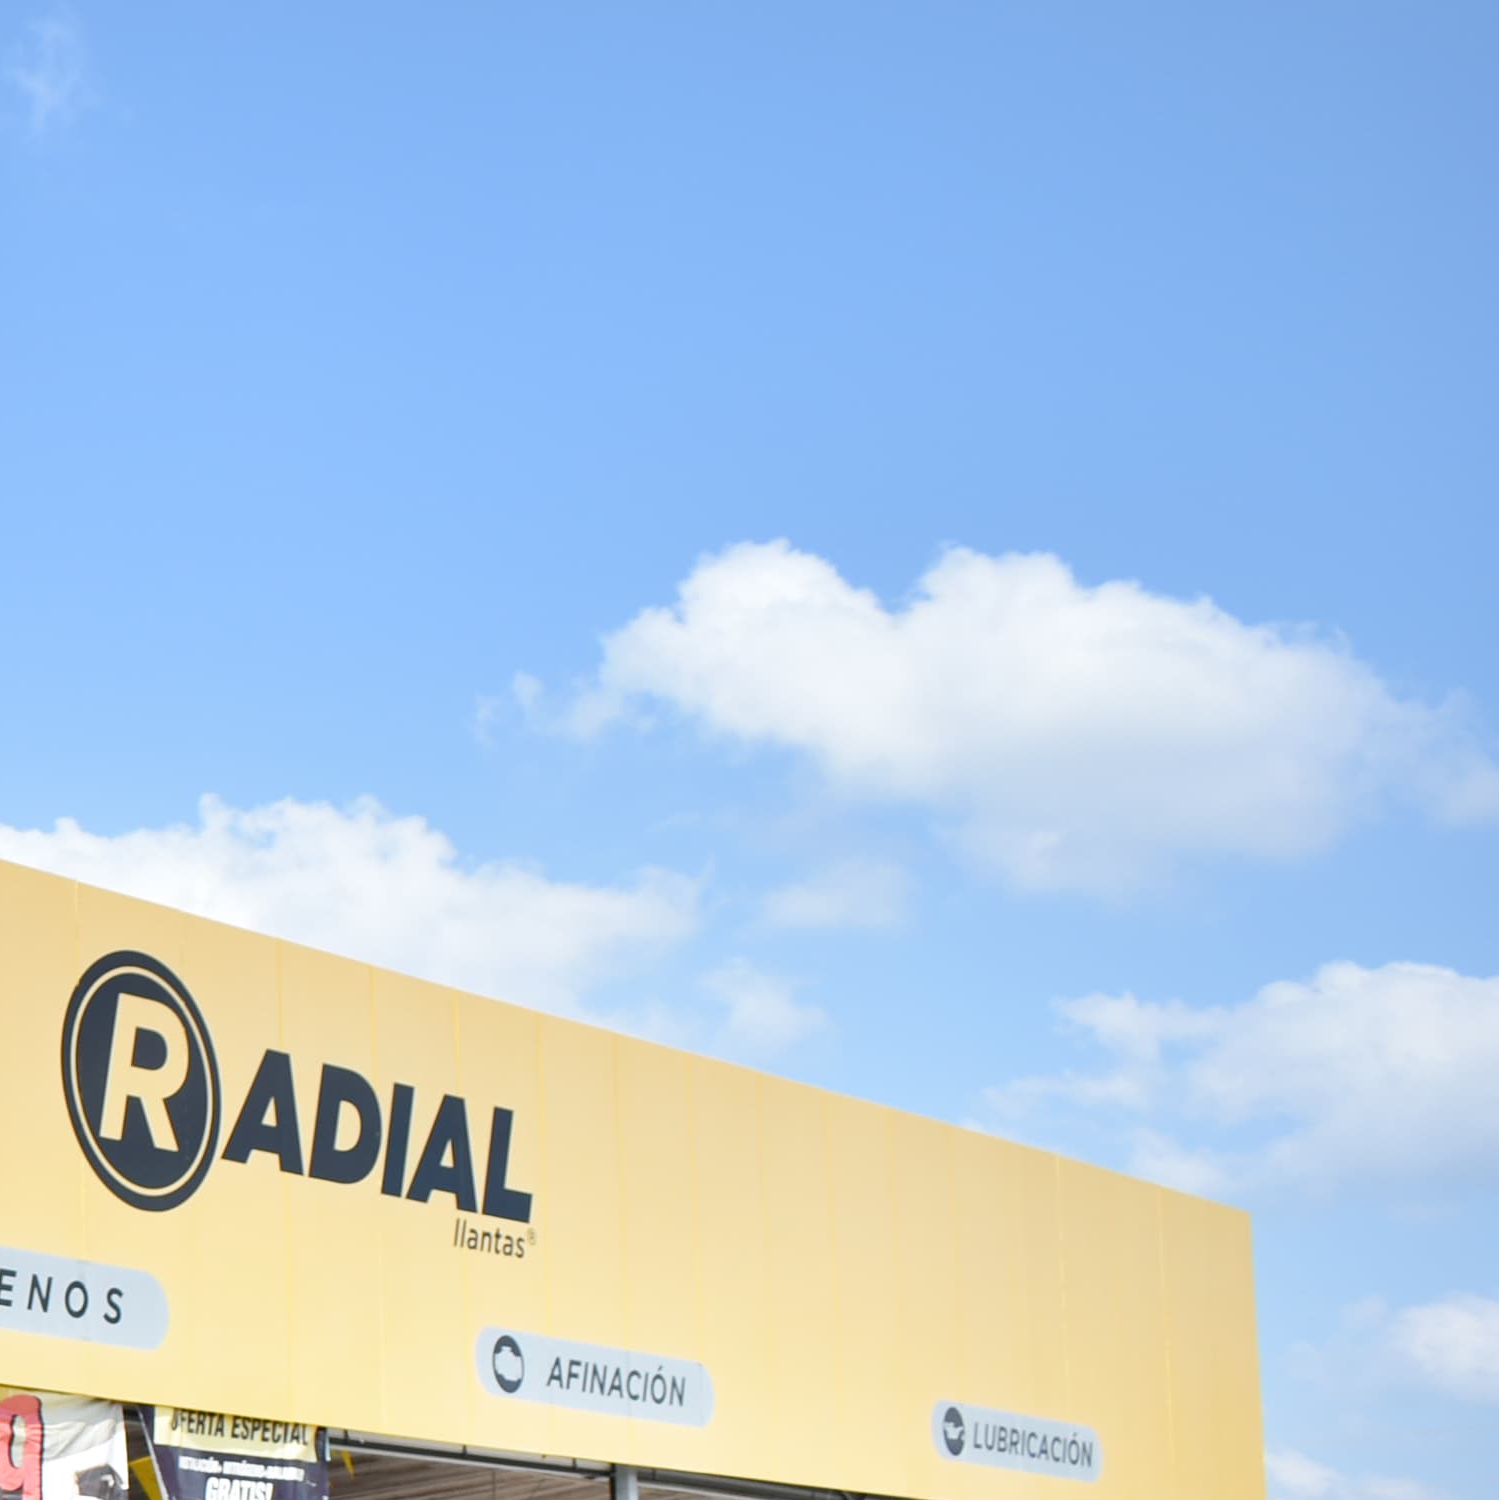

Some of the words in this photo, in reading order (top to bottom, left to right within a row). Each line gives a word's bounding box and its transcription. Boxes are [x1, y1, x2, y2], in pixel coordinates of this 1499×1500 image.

[81, 972, 533, 1223] RADIAL
[454, 1218, 526, 1259] llantas
[546, 1355, 687, 1407] AFINACIÓN
[231, 1415, 309, 1445] ESPECIAL
[972, 1421, 1094, 1469] LUBRICACIÓN
